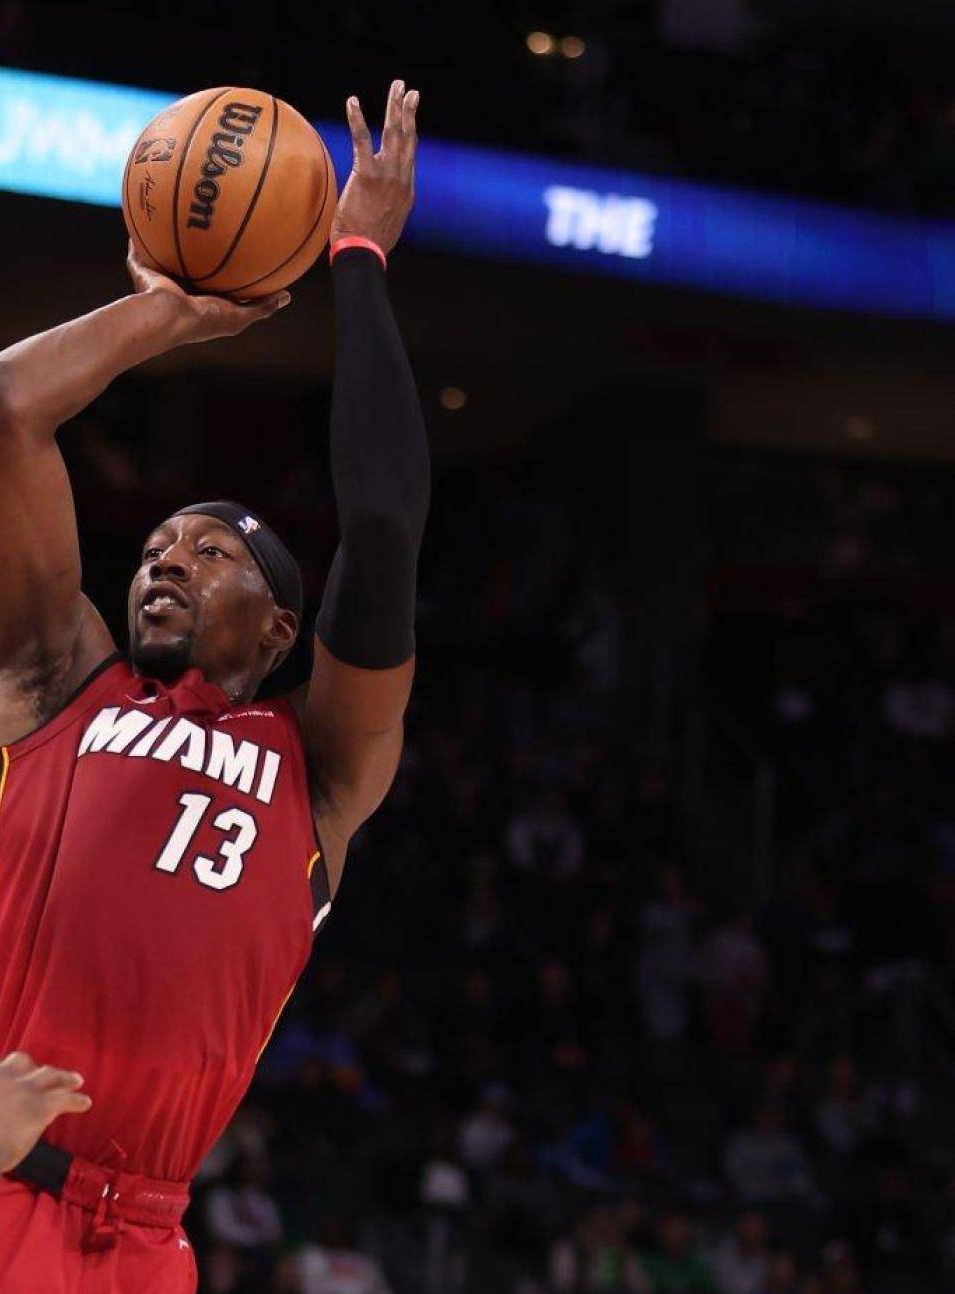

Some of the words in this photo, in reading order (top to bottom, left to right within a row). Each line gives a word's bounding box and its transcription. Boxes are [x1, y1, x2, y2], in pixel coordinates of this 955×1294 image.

[186, 102, 263, 230] Wilson
[544, 186, 657, 259] THE
[77, 706, 282, 804] MIAMI
[154, 791, 258, 890] 13
